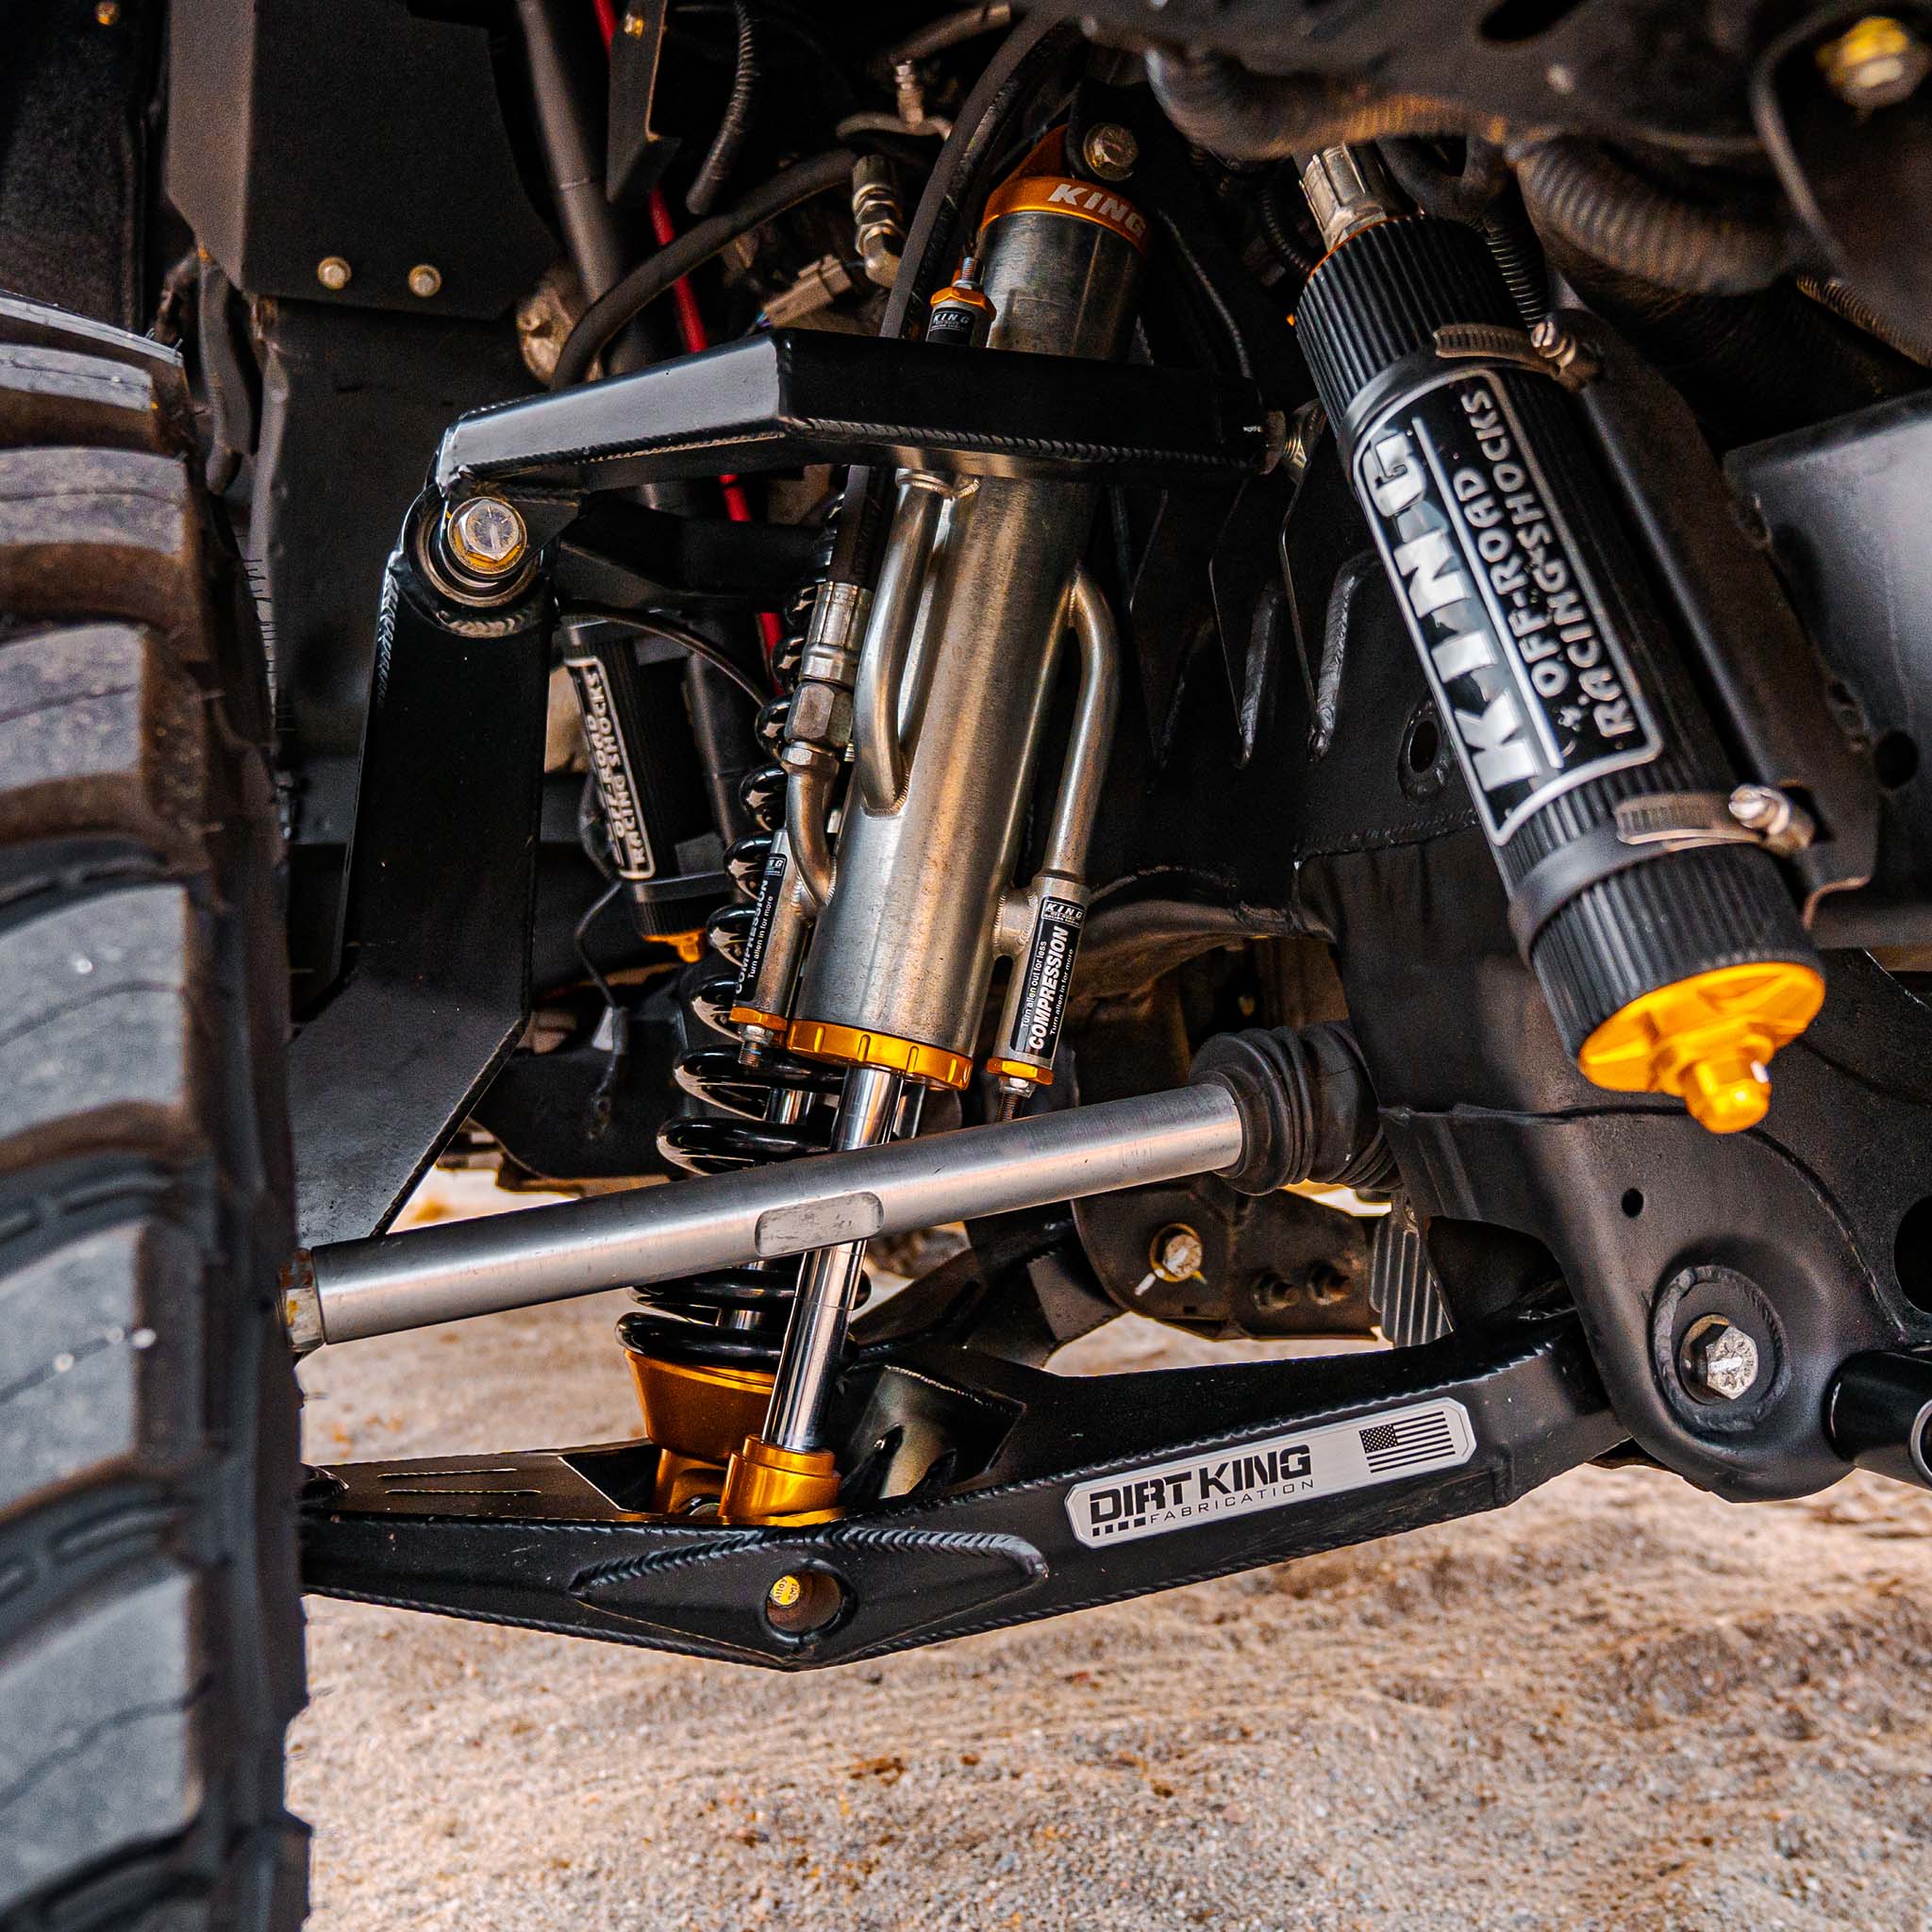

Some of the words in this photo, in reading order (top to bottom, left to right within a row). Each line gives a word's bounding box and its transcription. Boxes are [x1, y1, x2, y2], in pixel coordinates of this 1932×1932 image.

[1047, 183, 1146, 238] KING
[932, 312, 971, 325] KING
[1363, 429, 1541, 791] KING
[1453, 467, 1570, 698] OFF-ROAD
[588, 672, 621, 768] SHOCKS
[613, 774, 647, 865] RACING
[747, 959, 758, 978] Turn
[754, 939, 764, 959] allen
[764, 895, 774, 916] more
[1044, 903, 1083, 920] KING
[1031, 972, 1041, 989] out
[1039, 941, 1047, 958] less
[1021, 1008, 1032, 1027] Turn
[1025, 987, 1037, 1009] allen
[1028, 925, 1069, 1050] COMPRESSION
[1050, 1018, 1059, 1035] Turn
[1055, 994, 1064, 1018] allen
[1065, 948, 1074, 969] more
[1089, 1472, 1192, 1524] DIRT
[1199, 1444, 1312, 1500] KING
[1150, 1479, 1314, 1524] FABRICATION
